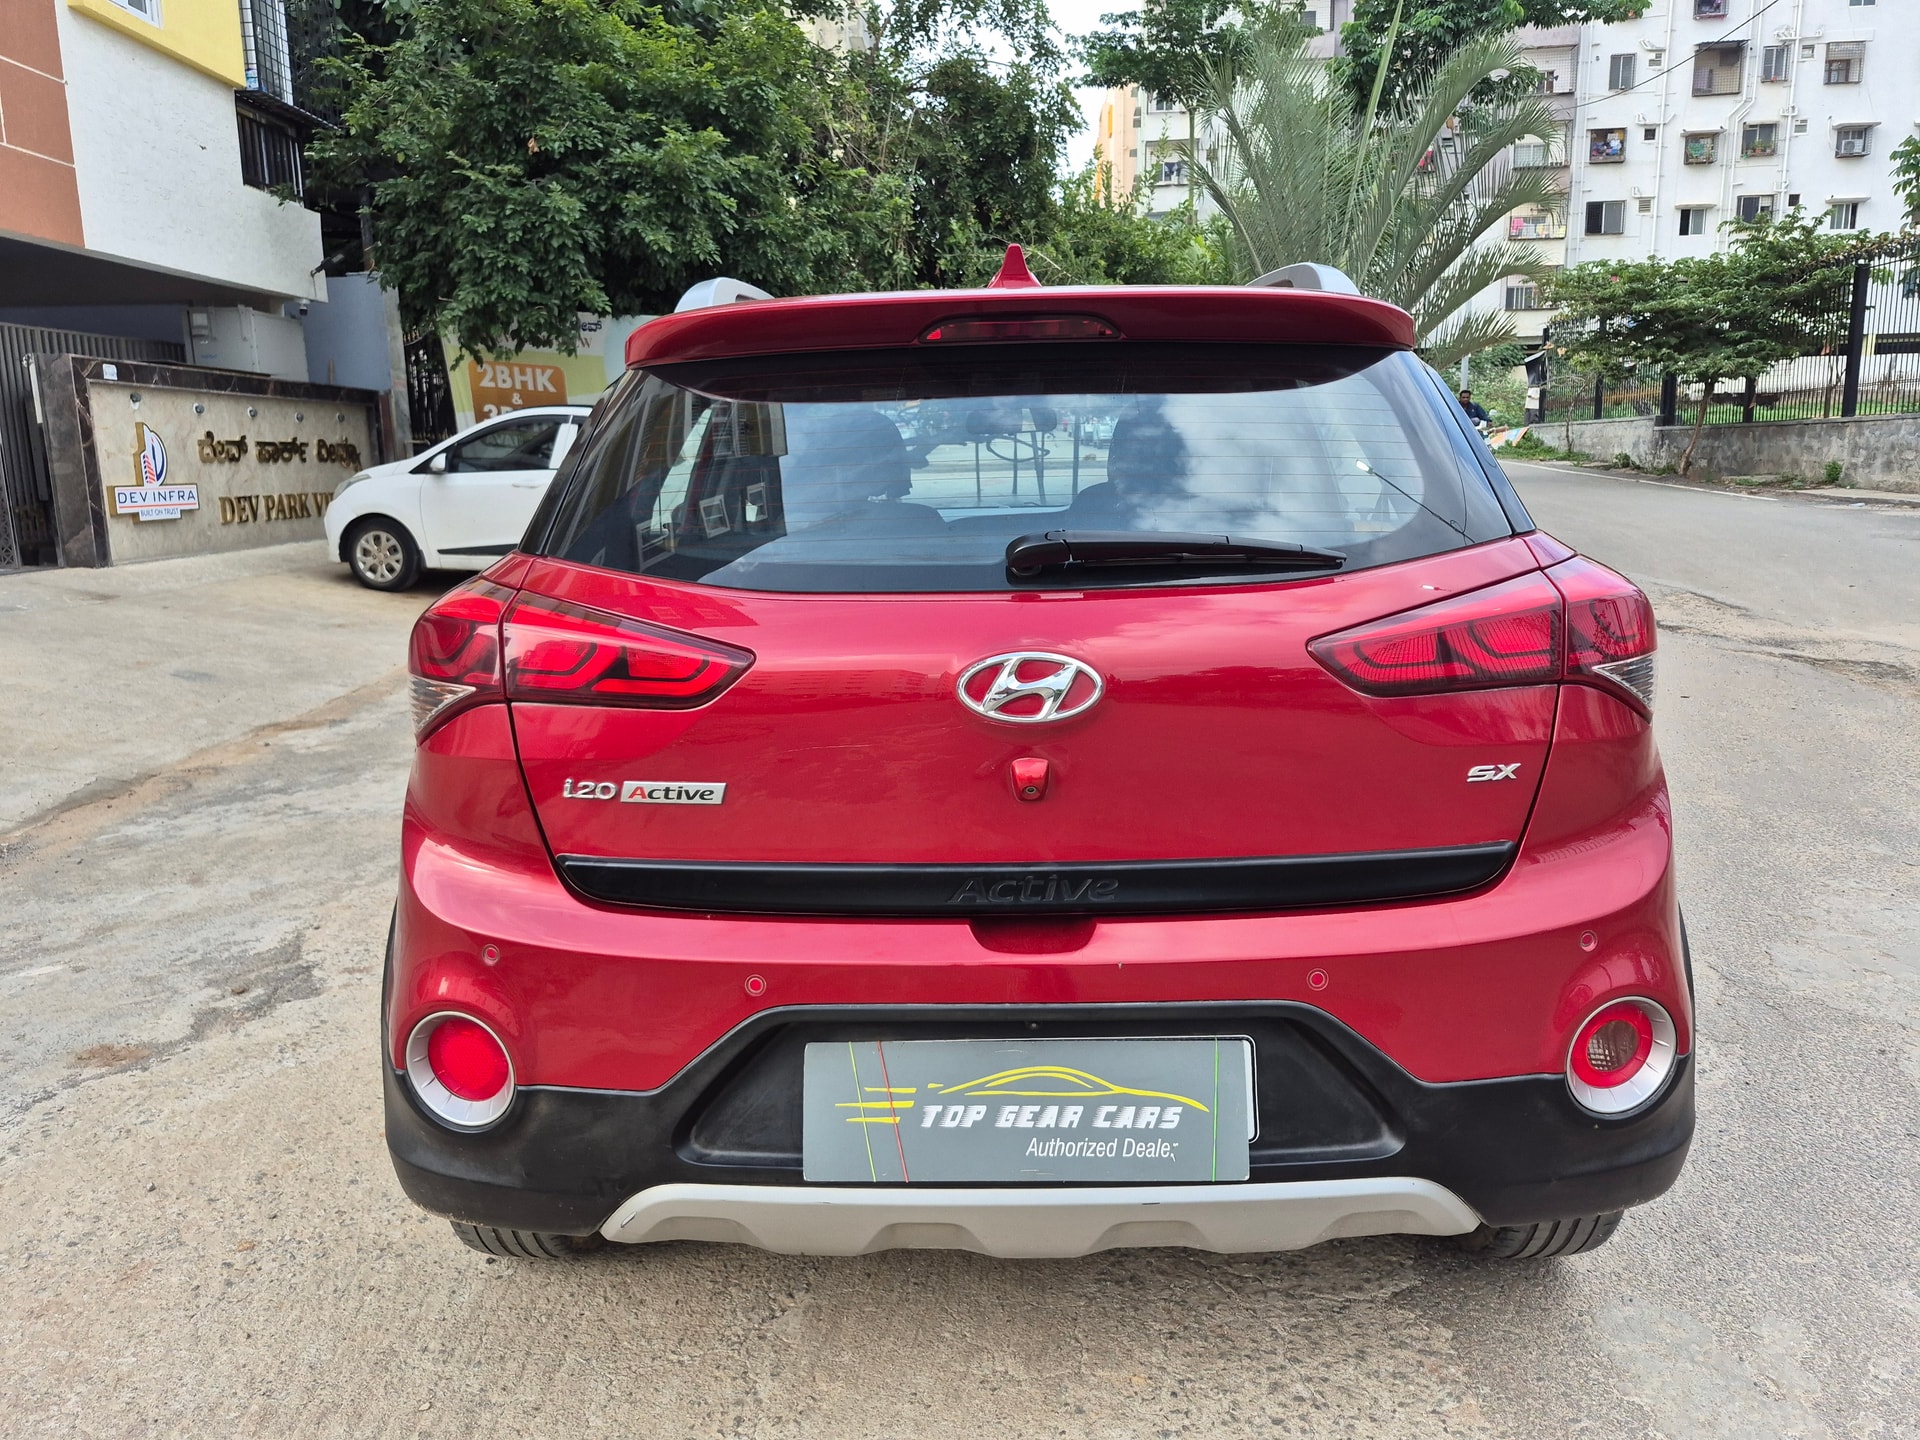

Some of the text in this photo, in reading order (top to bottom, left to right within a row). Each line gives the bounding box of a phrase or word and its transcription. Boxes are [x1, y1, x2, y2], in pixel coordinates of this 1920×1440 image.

[477, 363, 557, 393] 2BHK
[512, 393, 523, 405] &
[118, 490, 196, 504] DEV INFRA
[218, 496, 264, 525] DEV
[263, 493, 312, 521] PARK
[1467, 763, 1521, 782] SX
[563, 777, 715, 801] i20 Active
[947, 874, 1120, 904] Active
[920, 1105, 1183, 1129] TOP GEAR CARS
[1026, 1137, 1116, 1157] Authorized
